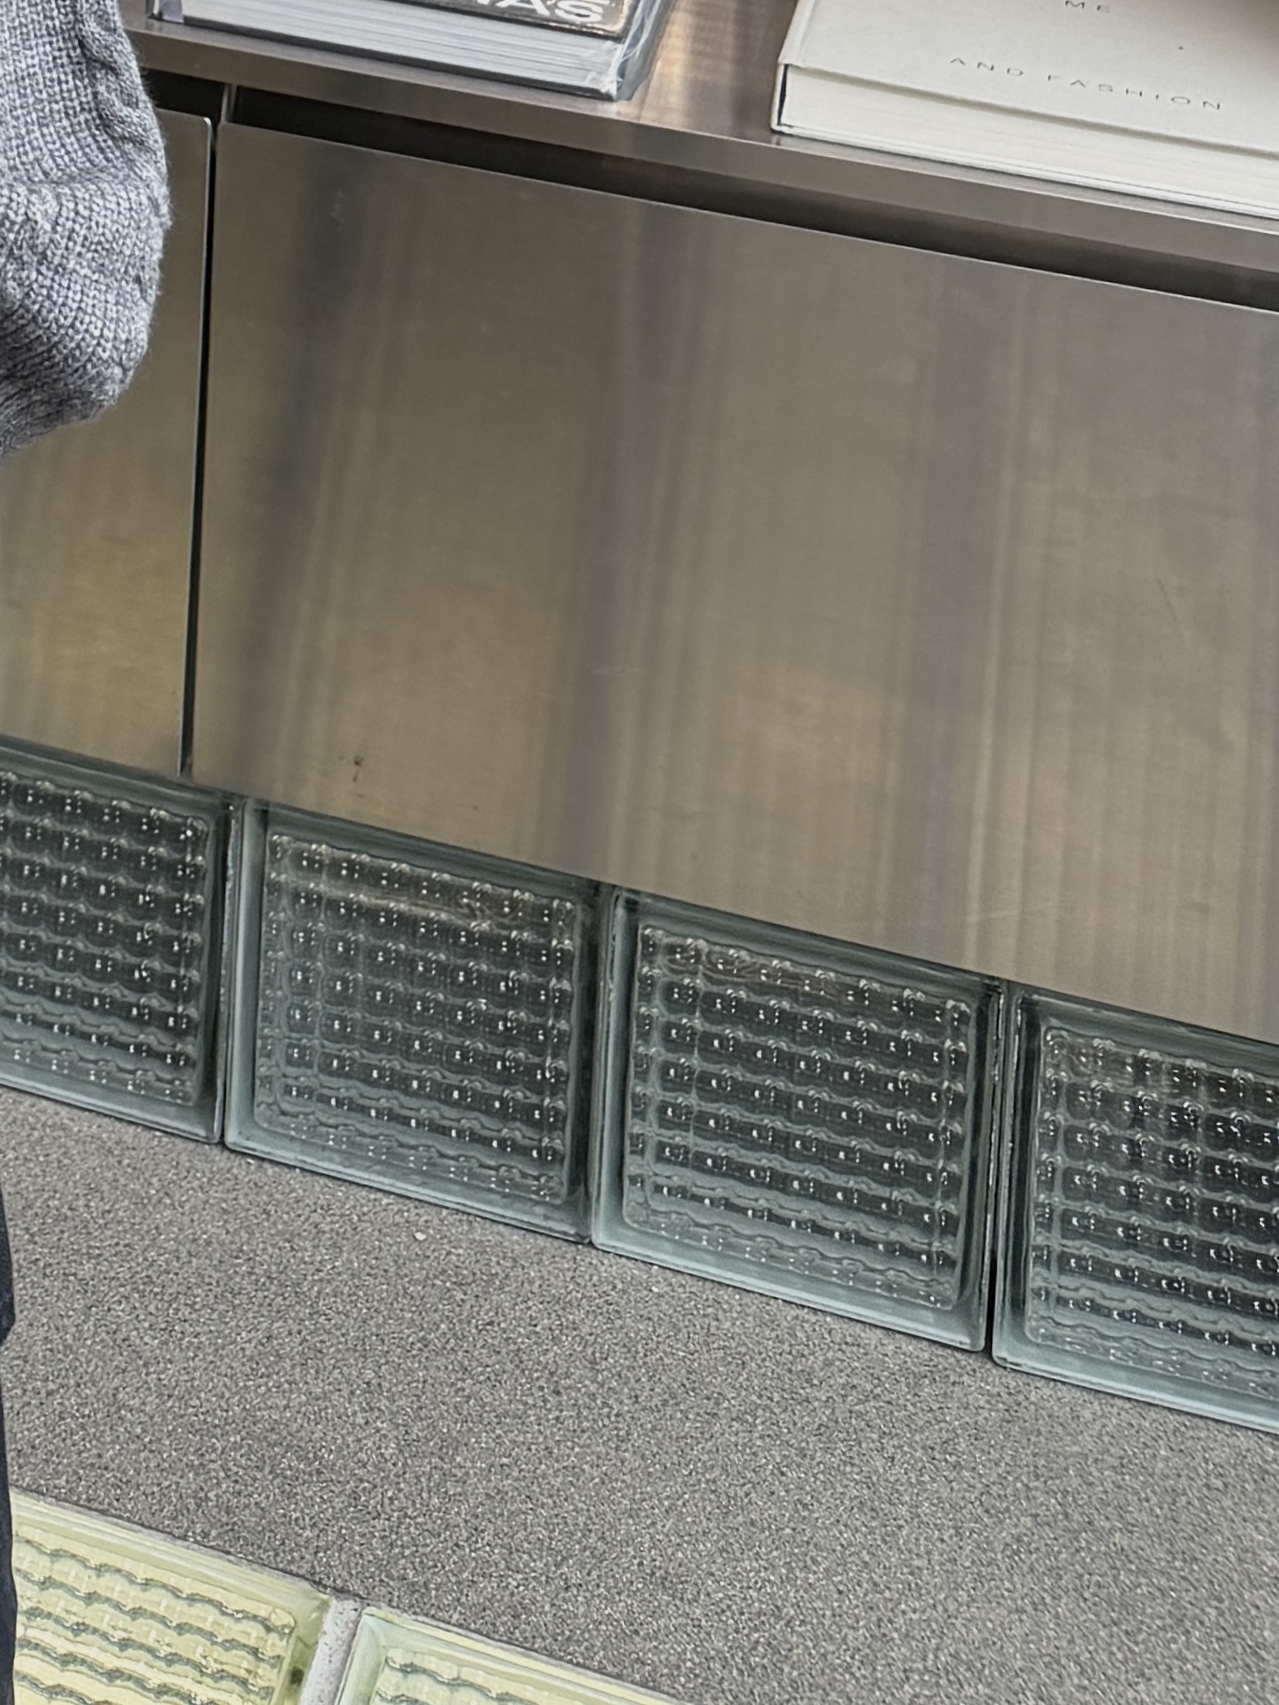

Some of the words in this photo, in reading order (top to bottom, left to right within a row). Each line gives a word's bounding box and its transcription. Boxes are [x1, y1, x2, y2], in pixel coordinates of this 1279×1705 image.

[1065, 0, 1110, 13] ME
[950, 57, 1024, 76] AND
[1047, 74, 1220, 111] FASHION
